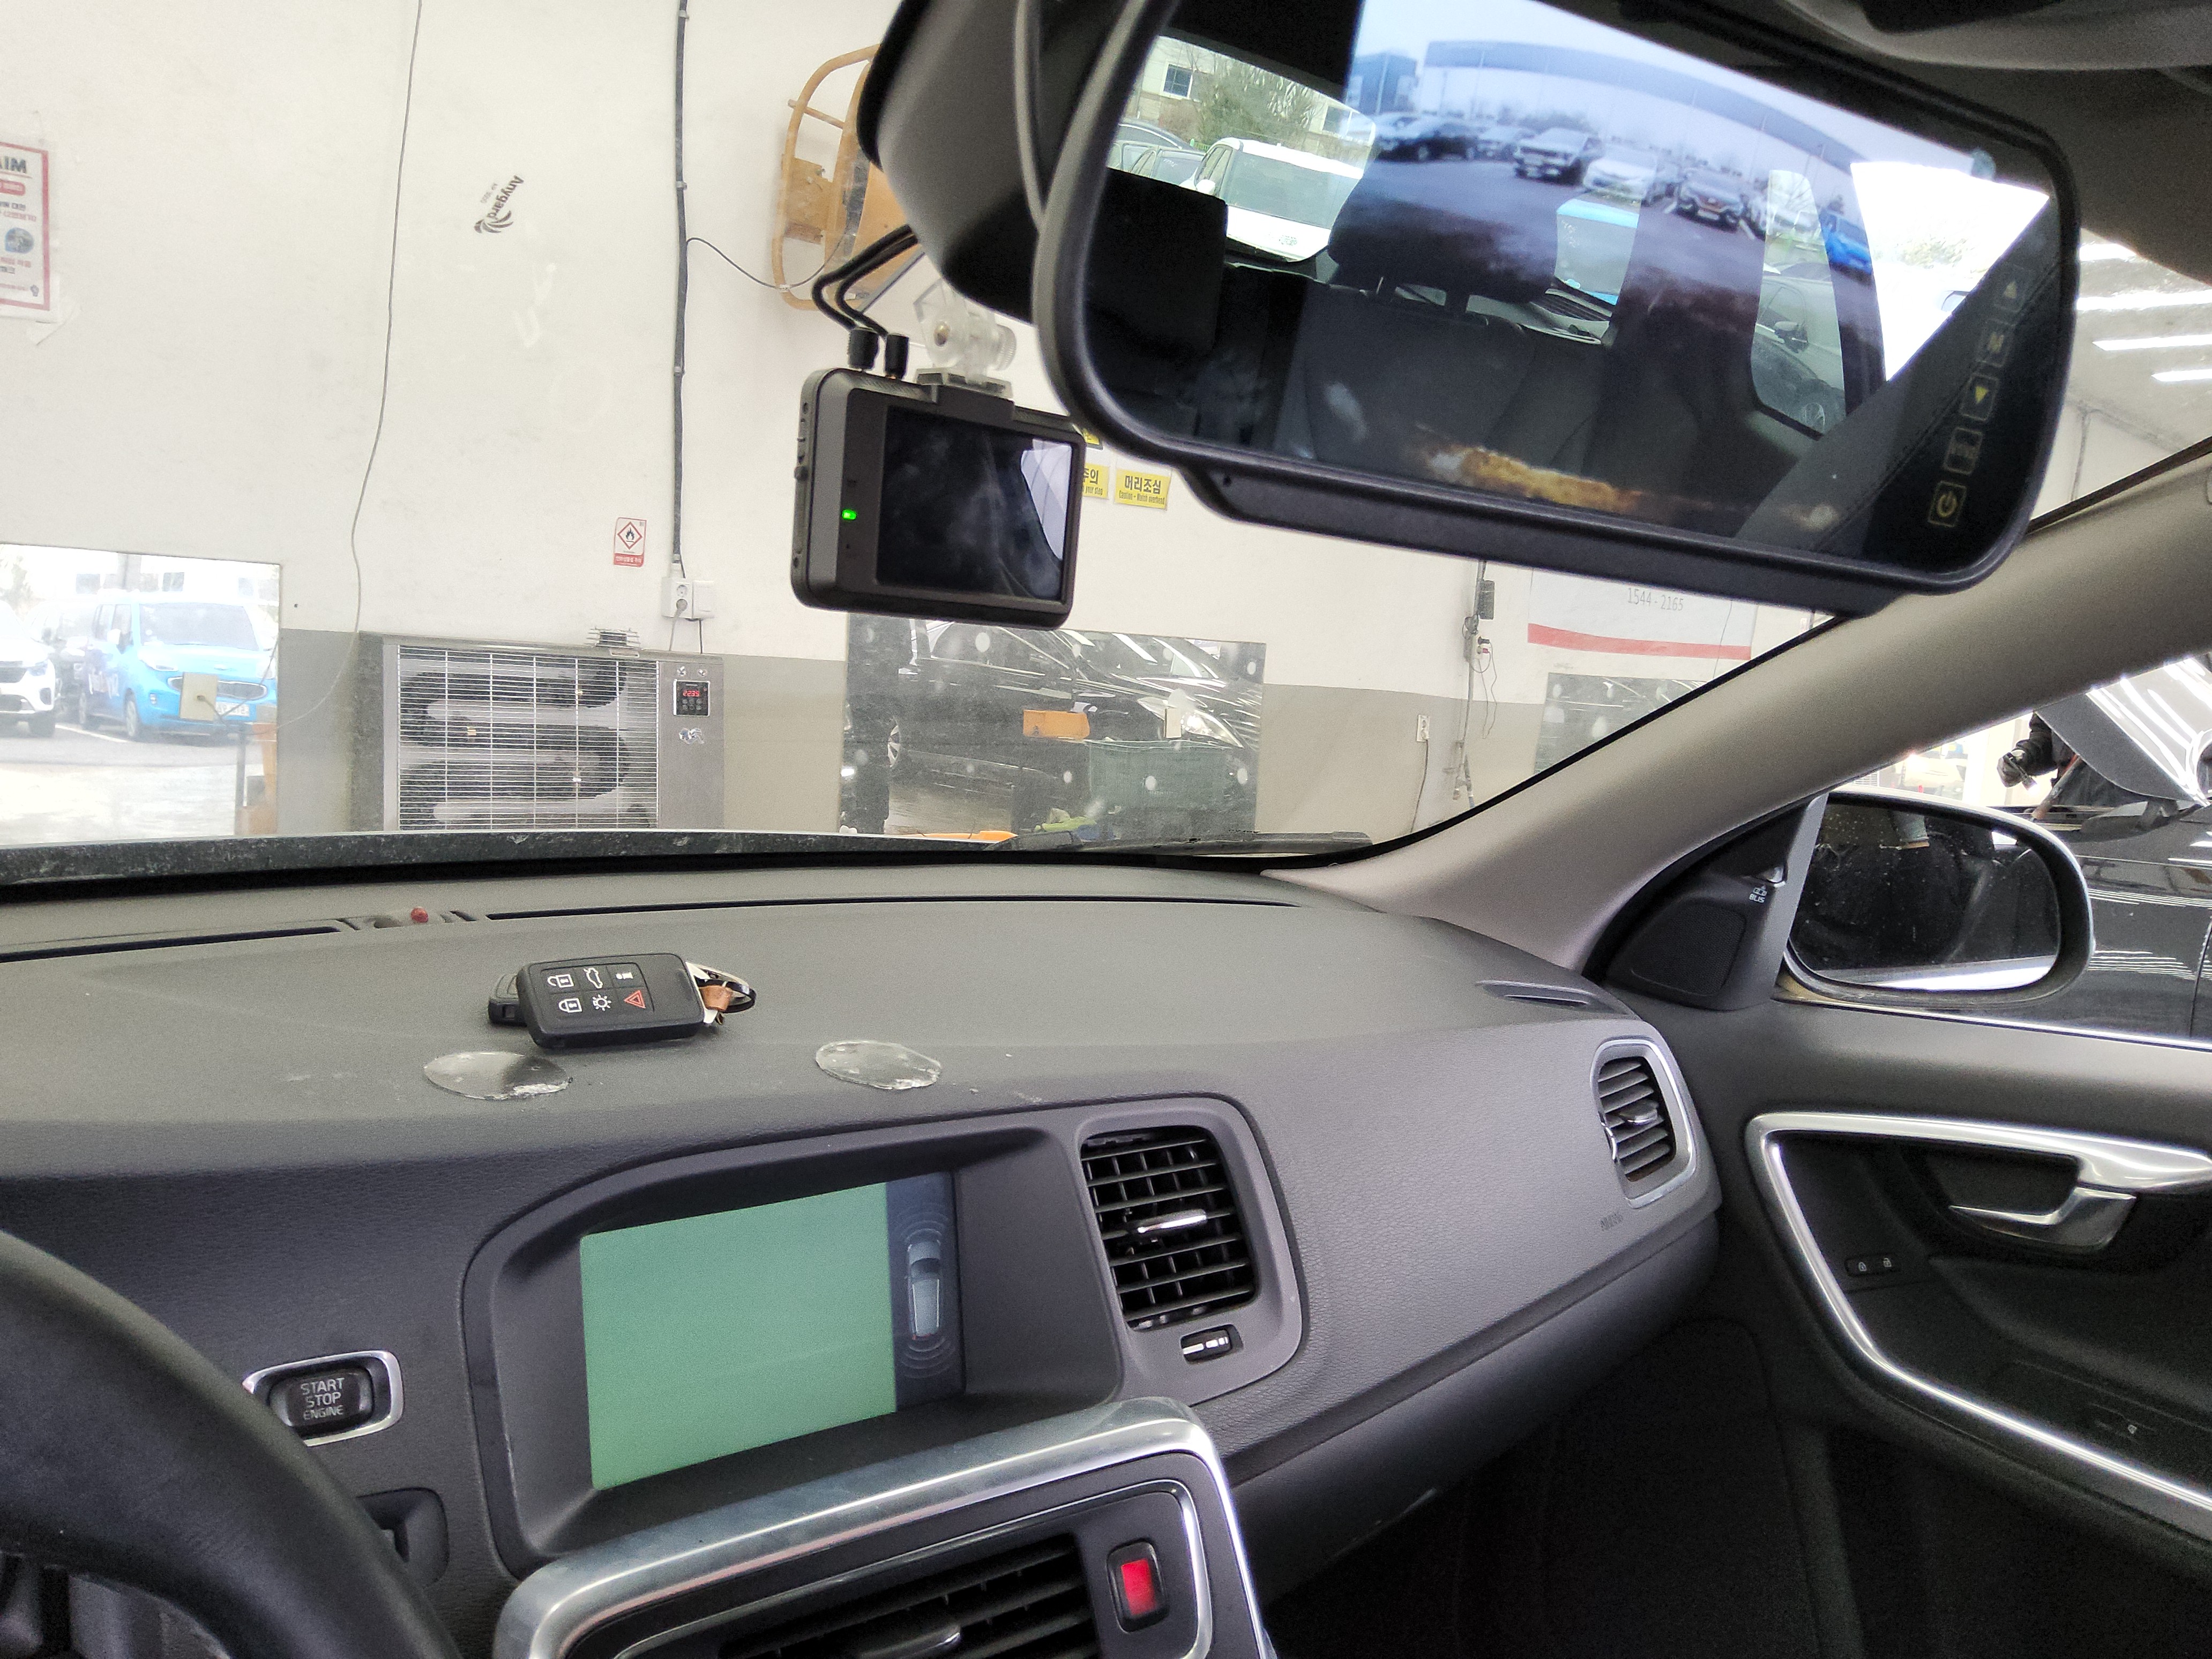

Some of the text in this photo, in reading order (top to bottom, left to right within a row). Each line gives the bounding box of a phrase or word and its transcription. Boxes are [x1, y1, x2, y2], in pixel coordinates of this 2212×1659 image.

[0, 156, 26, 173] IM
[487, 175, 524, 220] Anygard
[1125, 475, 1161, 495] 머리조심
[301, 1377, 345, 1395] START
[306, 1392, 341, 1408] STOP
[303, 1404, 343, 1421] ENGINE
